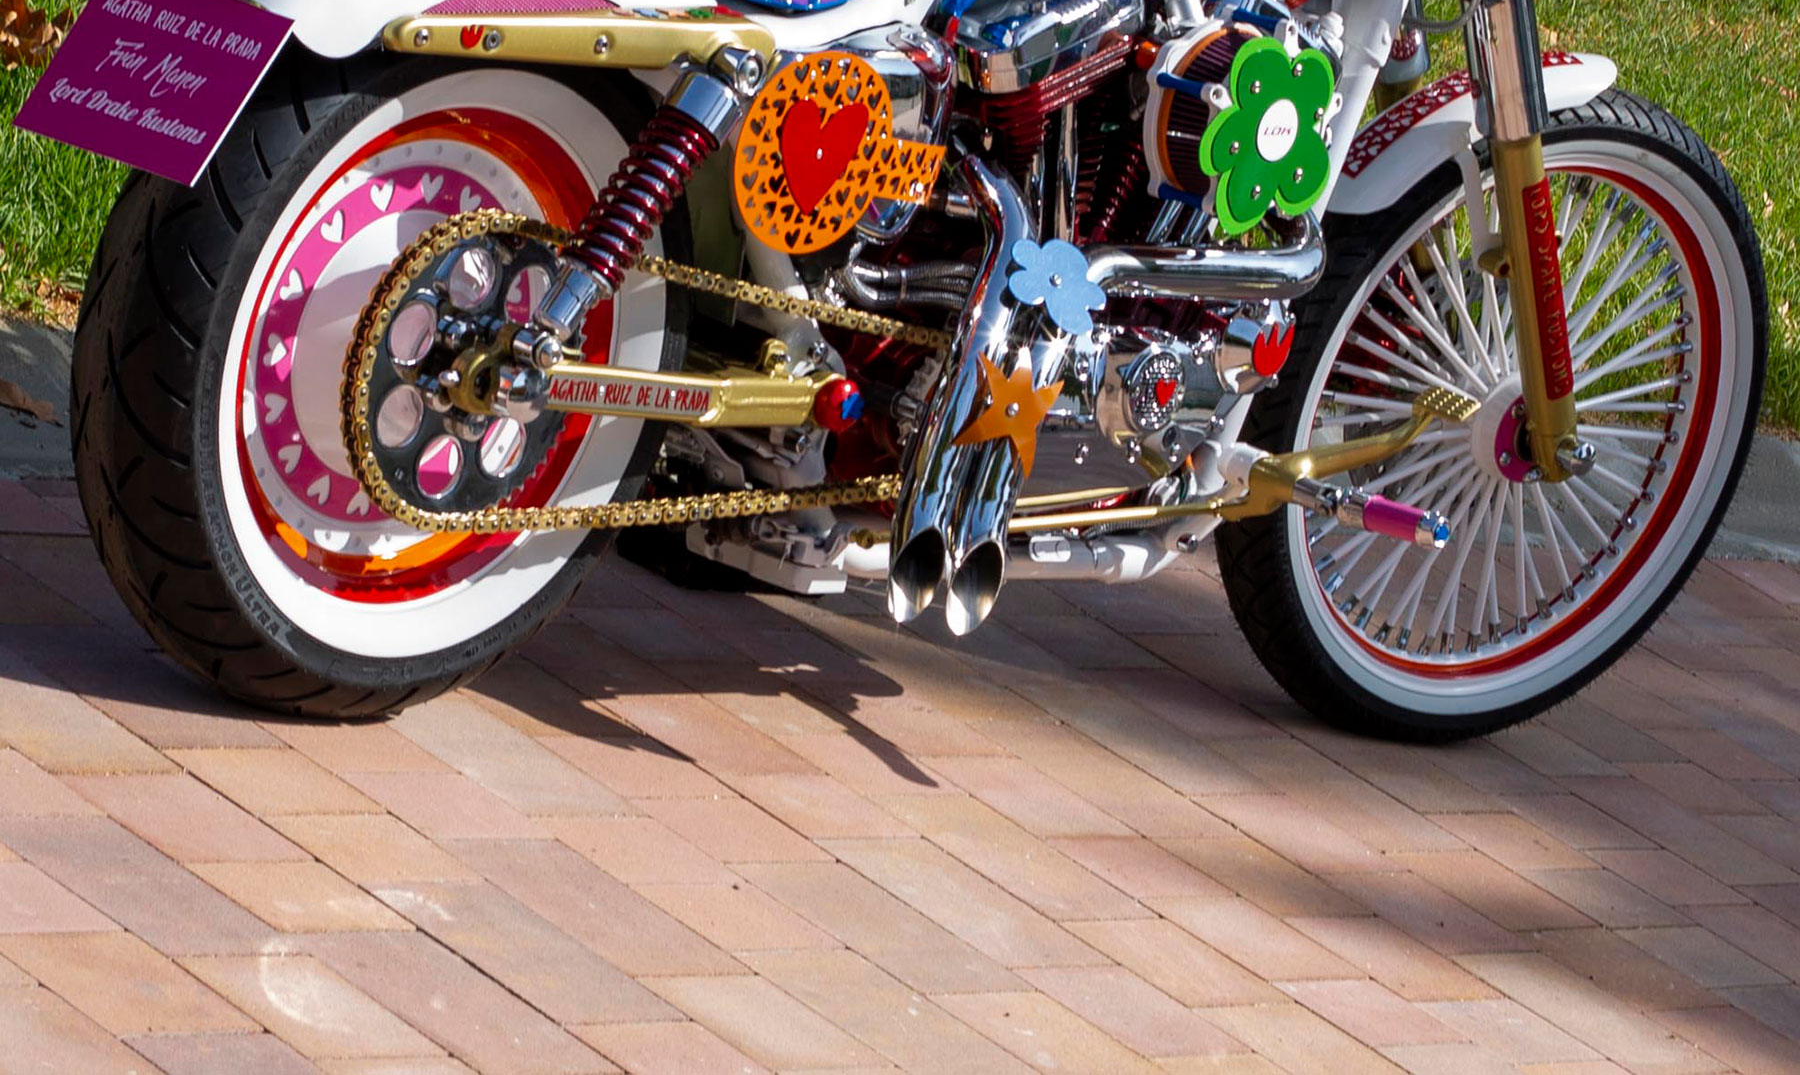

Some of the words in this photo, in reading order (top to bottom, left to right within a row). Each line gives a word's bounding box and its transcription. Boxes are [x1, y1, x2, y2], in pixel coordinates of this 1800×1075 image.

[95, 38, 148, 78] Fran
[154, 9, 186, 35] RUIZ
[184, 20, 205, 41] DE
[203, 26, 222, 46] LA
[221, 31, 262, 61] PRADA
[49, 78, 90, 104] Lord
[86, 90, 139, 122] Drake
[136, 107, 207, 145] Kustoms
[549, 378, 599, 403] AGATHA
[603, 382, 634, 405] RUIZ
[636, 385, 653, 407] DE
[654, 387, 671, 408] LA
[673, 388, 710, 411] PRADA
